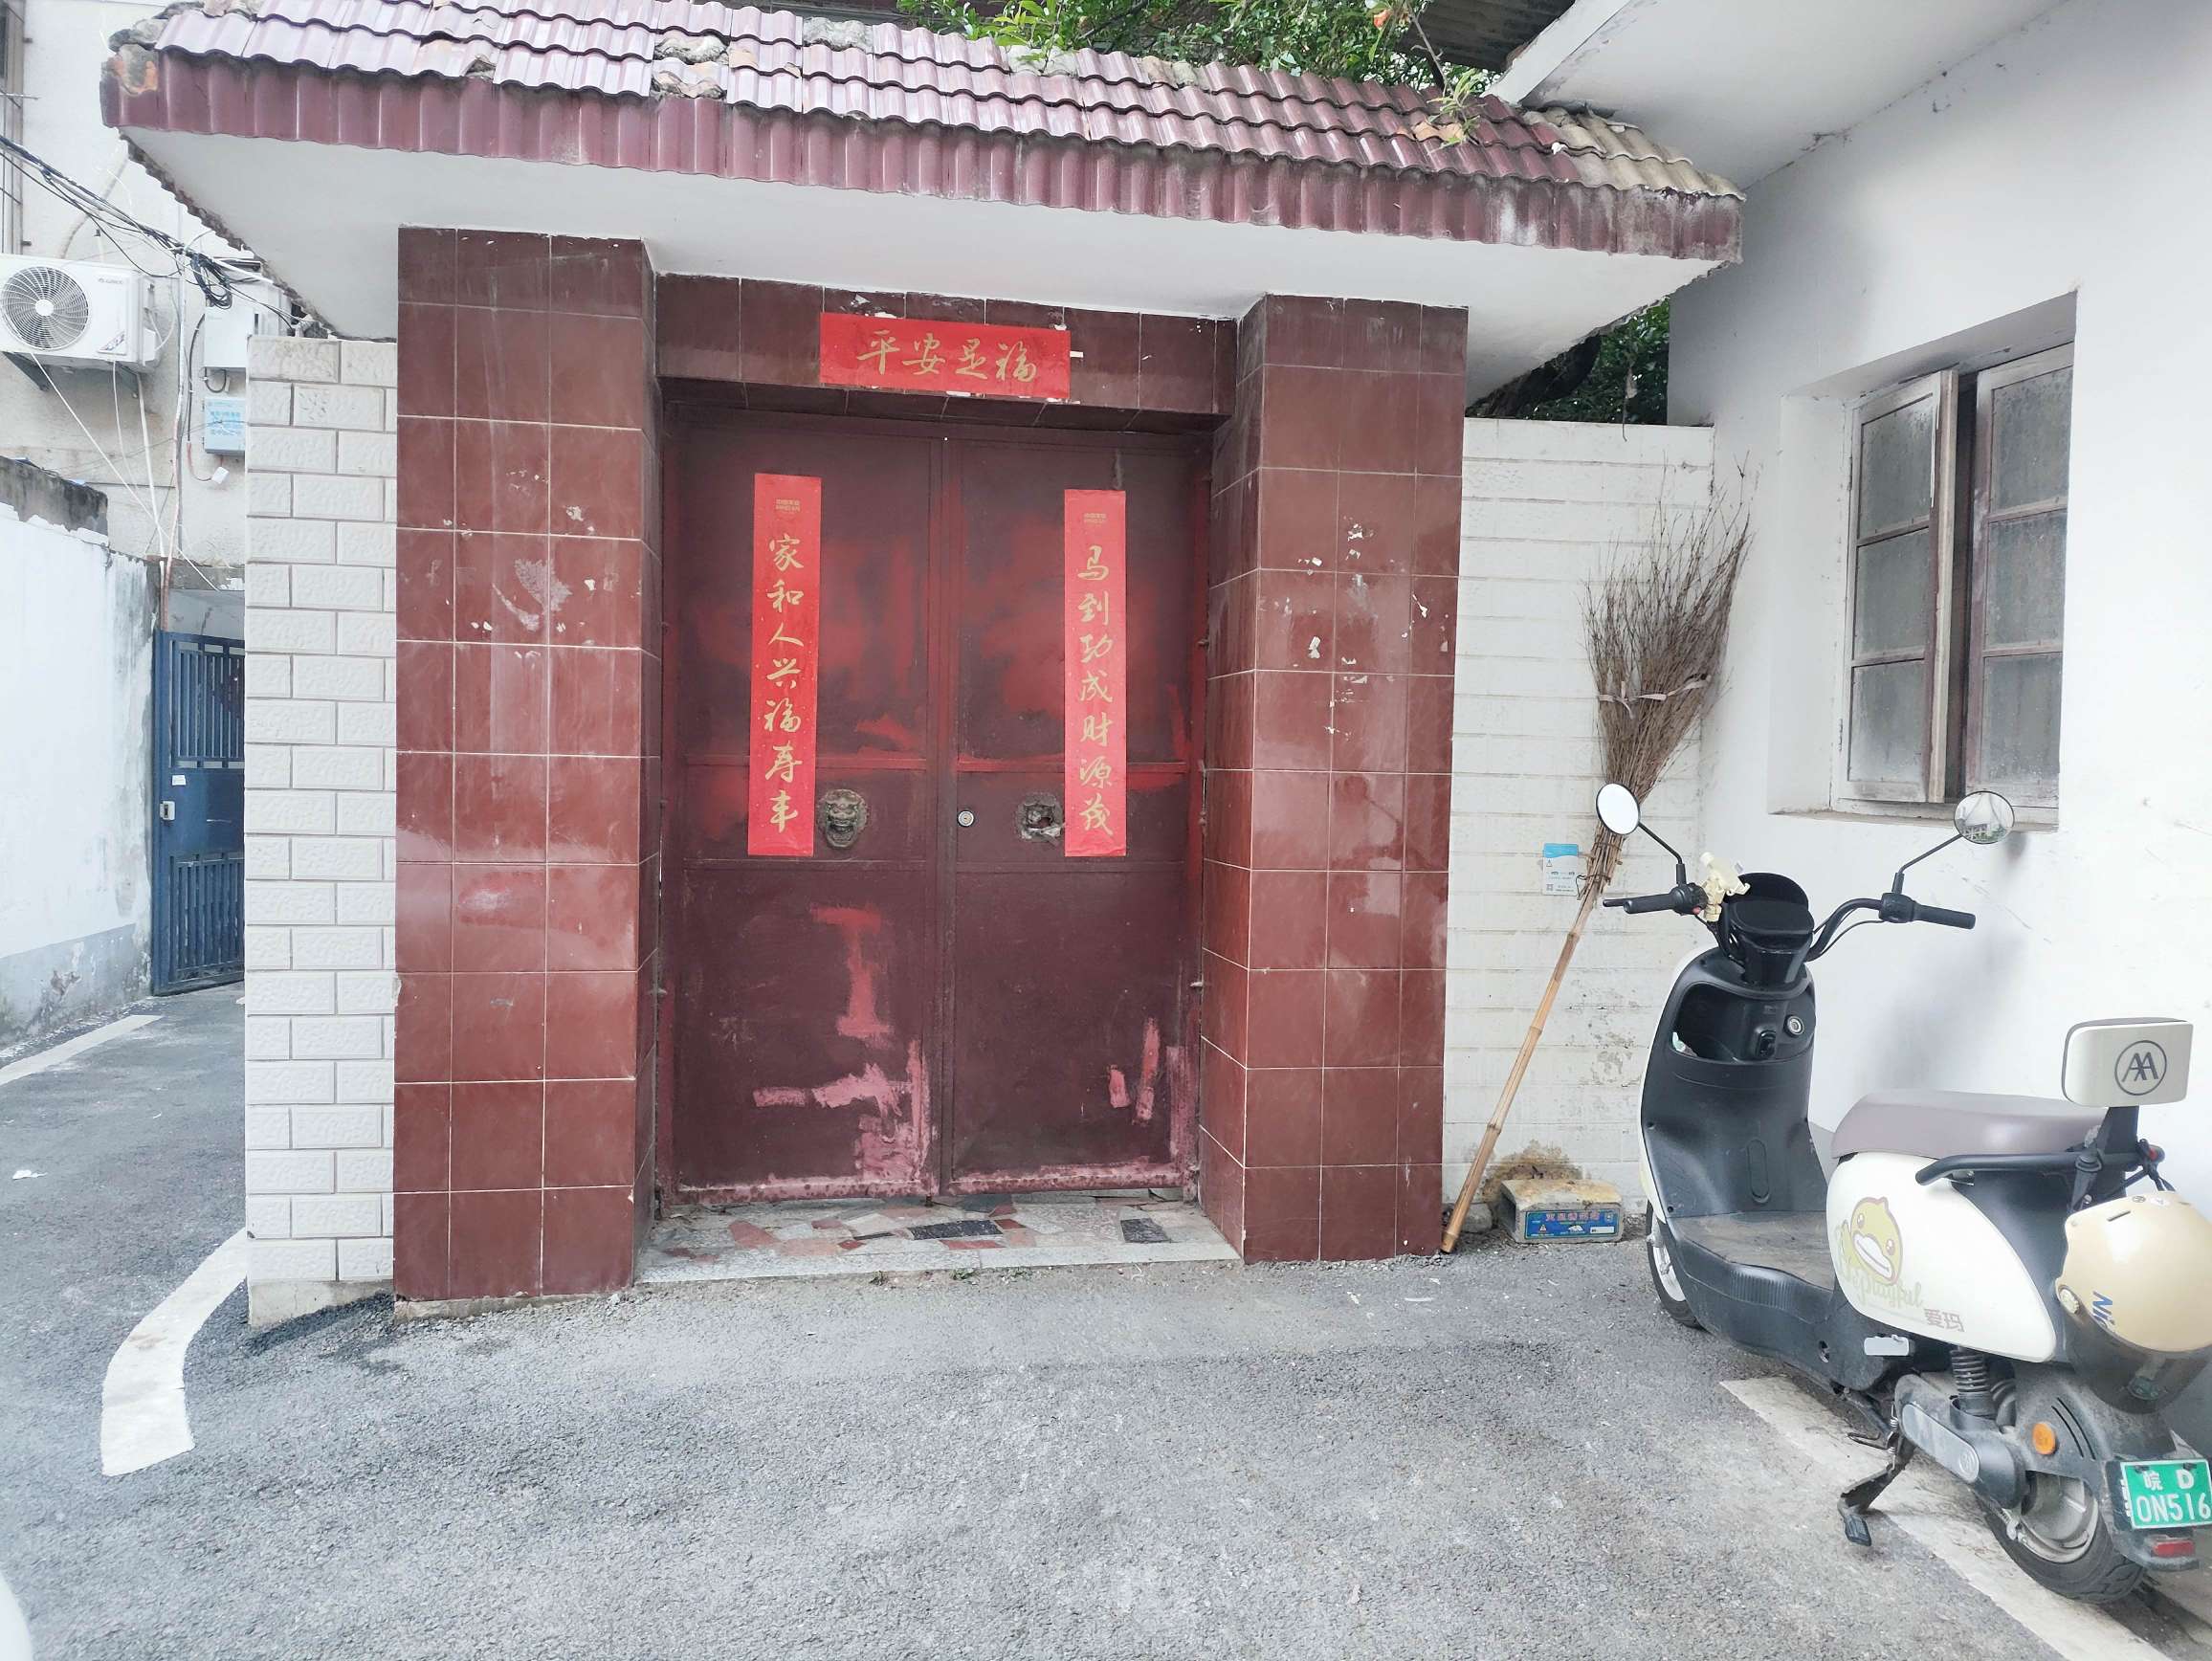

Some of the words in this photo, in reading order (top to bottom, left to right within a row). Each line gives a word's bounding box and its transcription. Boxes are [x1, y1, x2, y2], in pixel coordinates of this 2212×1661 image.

[856, 328, 1038, 383] 平安是福
[1076, 544, 1114, 836] 马到功成财源茂
[1924, 1308, 1966, 1333] 爱玛
[2175, 1469, 2195, 1490] D
